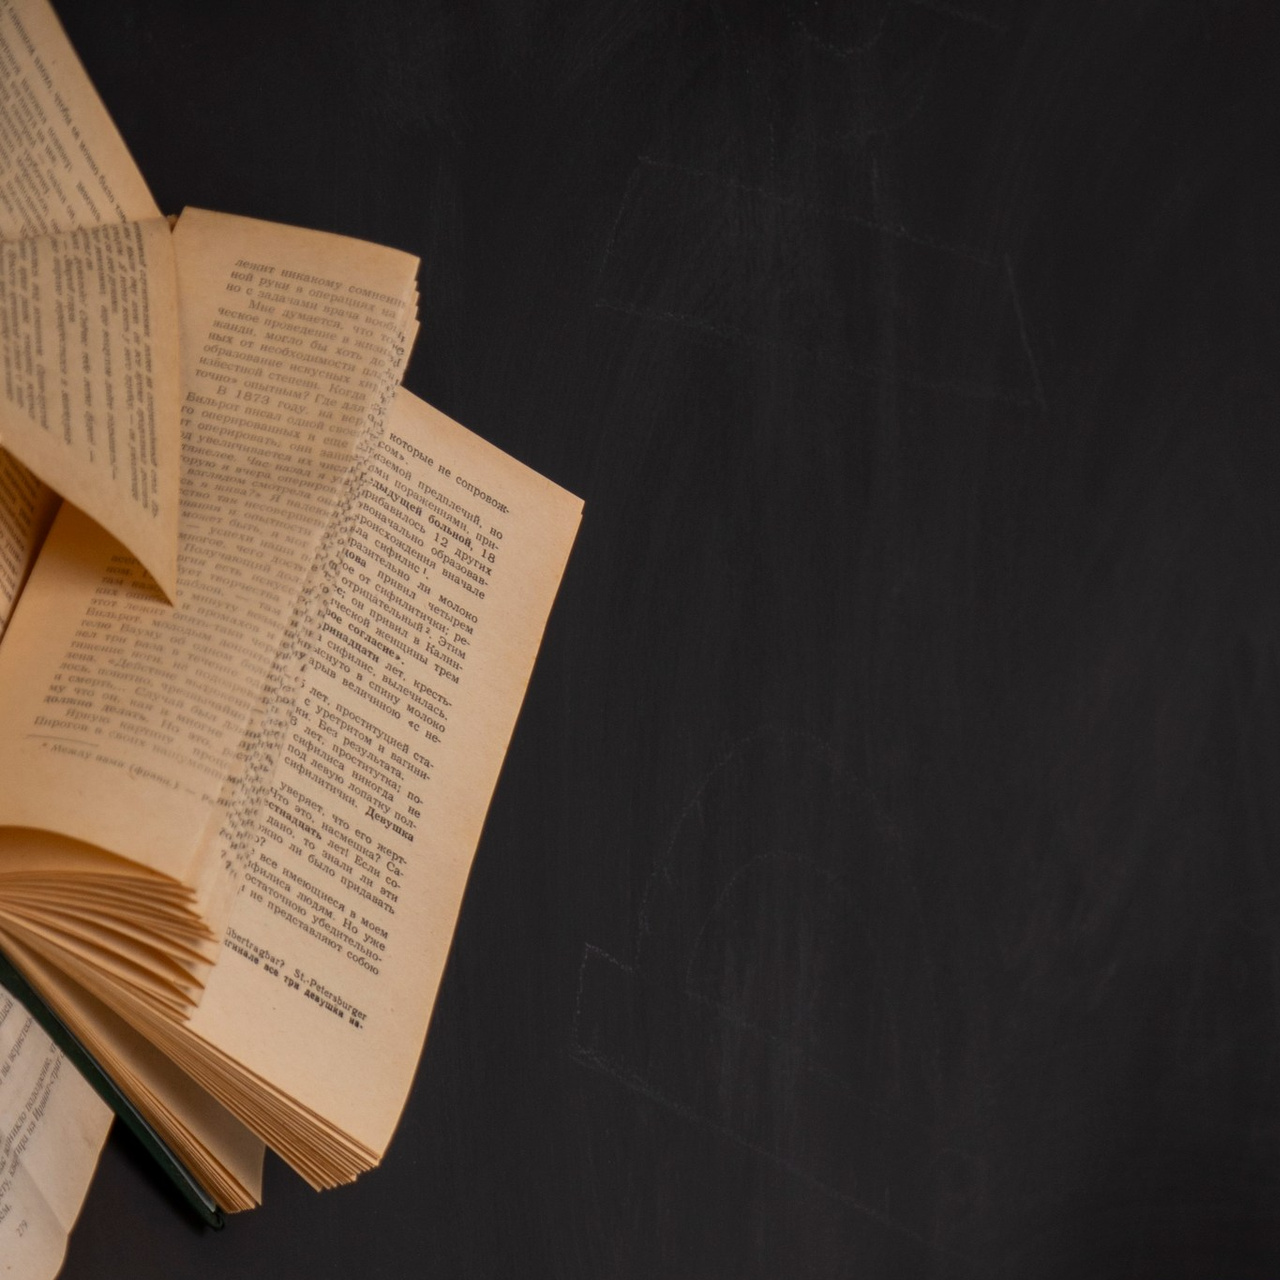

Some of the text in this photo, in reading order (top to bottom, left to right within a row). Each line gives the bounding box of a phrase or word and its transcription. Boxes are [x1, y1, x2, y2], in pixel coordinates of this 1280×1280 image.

[389, 433, 510, 514] которые не сопровож-
[418, 481, 503, 540] предплечий, но
[428, 514, 496, 563] больной, 18
[434, 532, 492, 576] 12 других
[431, 547, 488, 586] образовав-
[442, 568, 485, 600] вначале
[417, 582, 478, 623] ли молоко
[428, 602, 474, 635] четырем
[365, 806, 414, 842] Девушка
[267, 901, 379, 975] представляют собою
[311, 915, 382, 962] убедительно-
